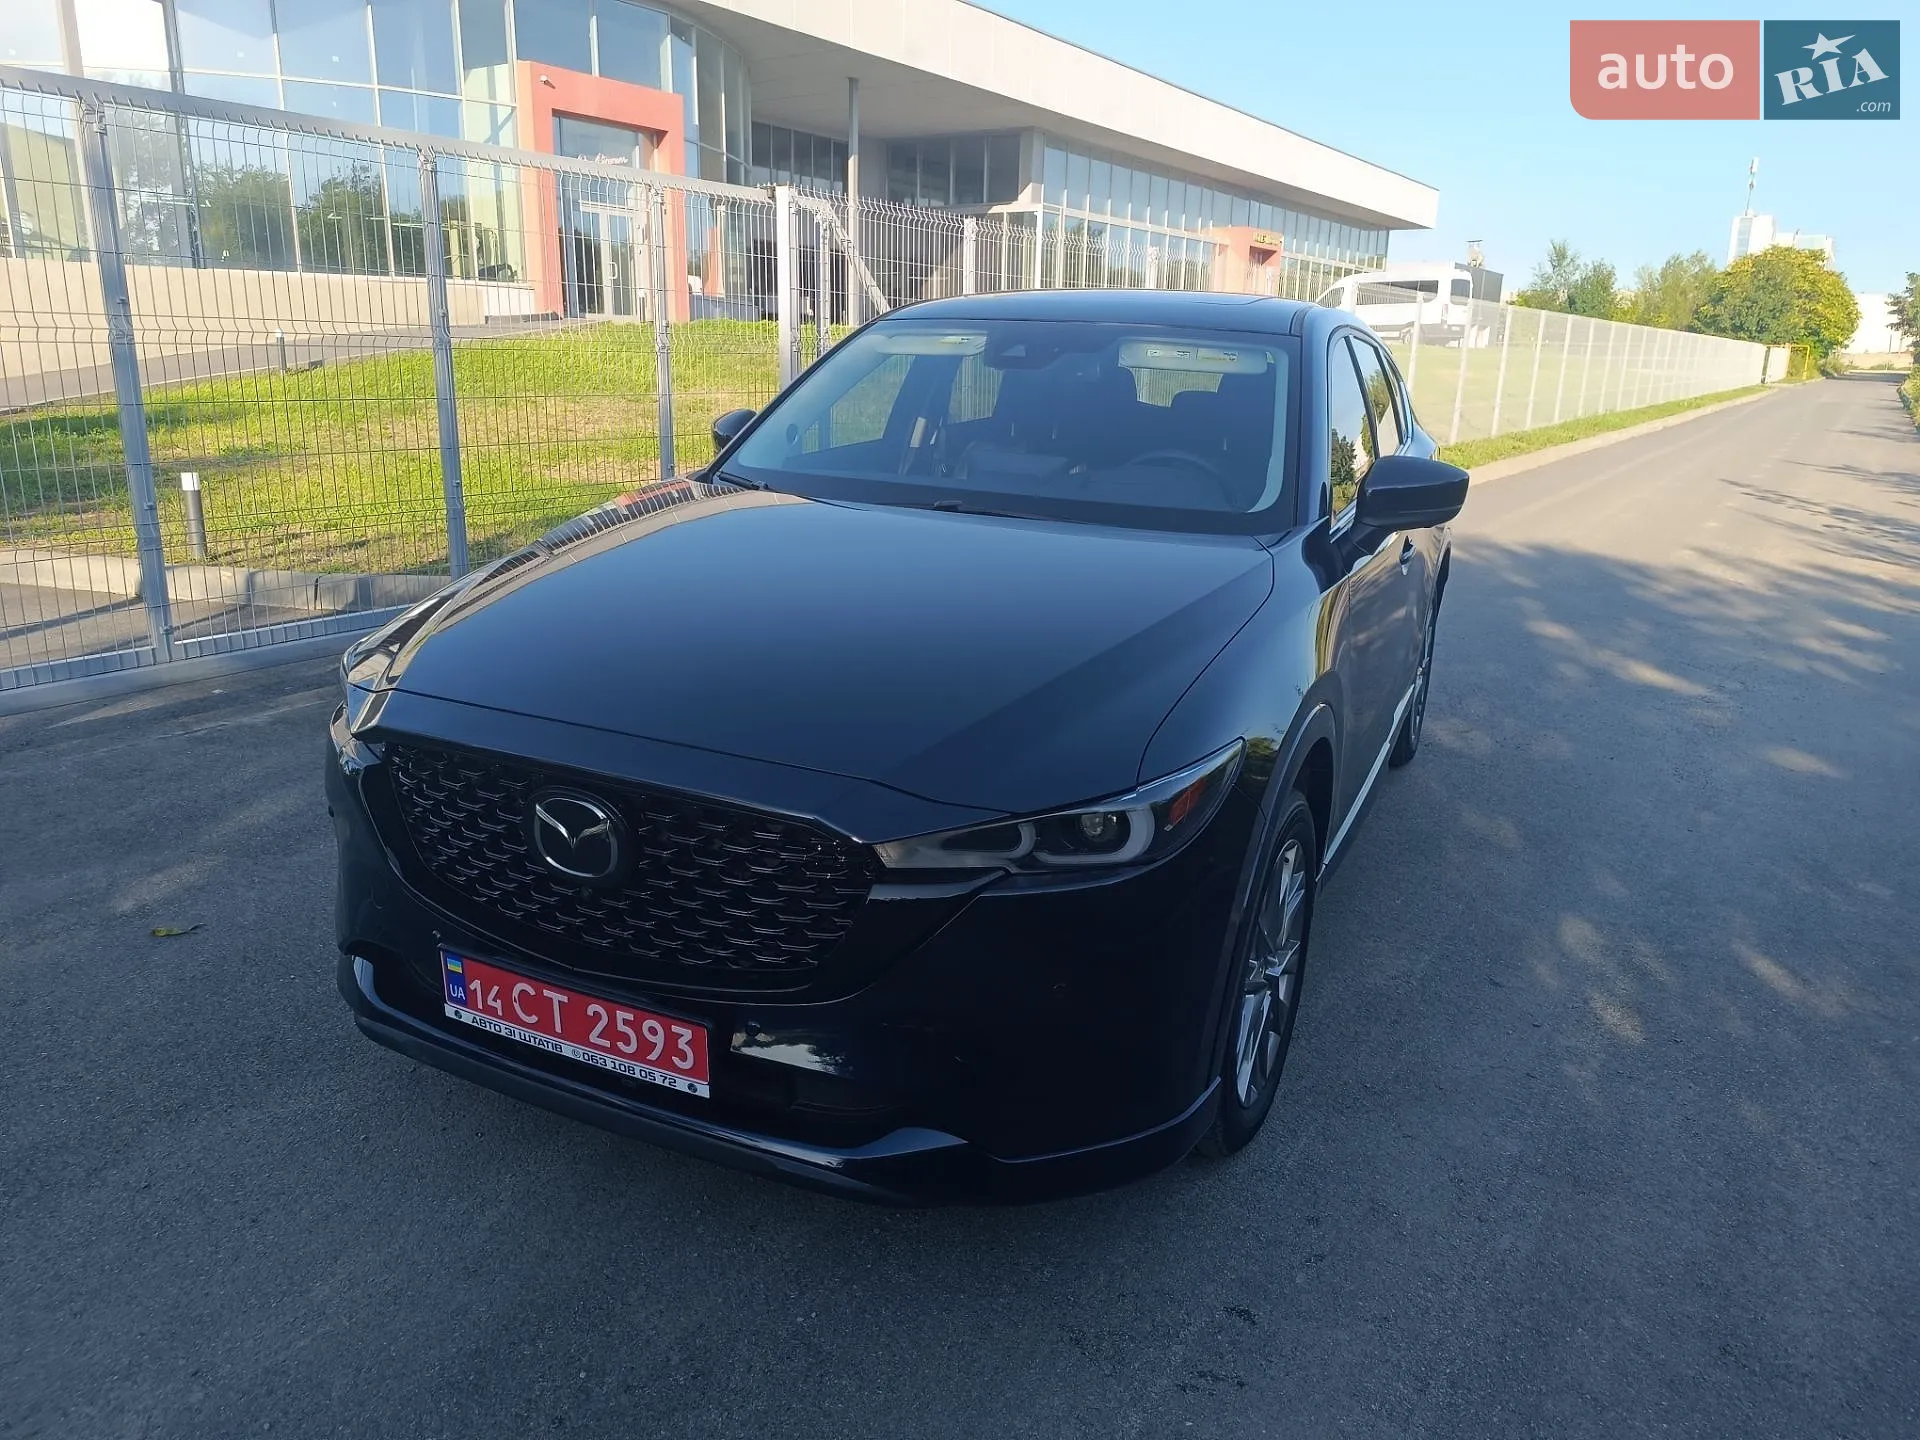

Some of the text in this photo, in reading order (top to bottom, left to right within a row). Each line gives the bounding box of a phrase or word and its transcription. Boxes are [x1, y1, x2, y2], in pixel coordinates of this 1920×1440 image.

[449, 983, 466, 1001] UA
[471, 1015, 502, 1034] АВТО
[519, 1031, 563, 1054] ШТАТІВ
[582, 1051, 608, 1067] 063
[611, 1061, 636, 1076] 108
[639, 1068, 657, 1082] 05
[659, 1074, 677, 1088] 72
[586, 1003, 695, 1070] 2593
